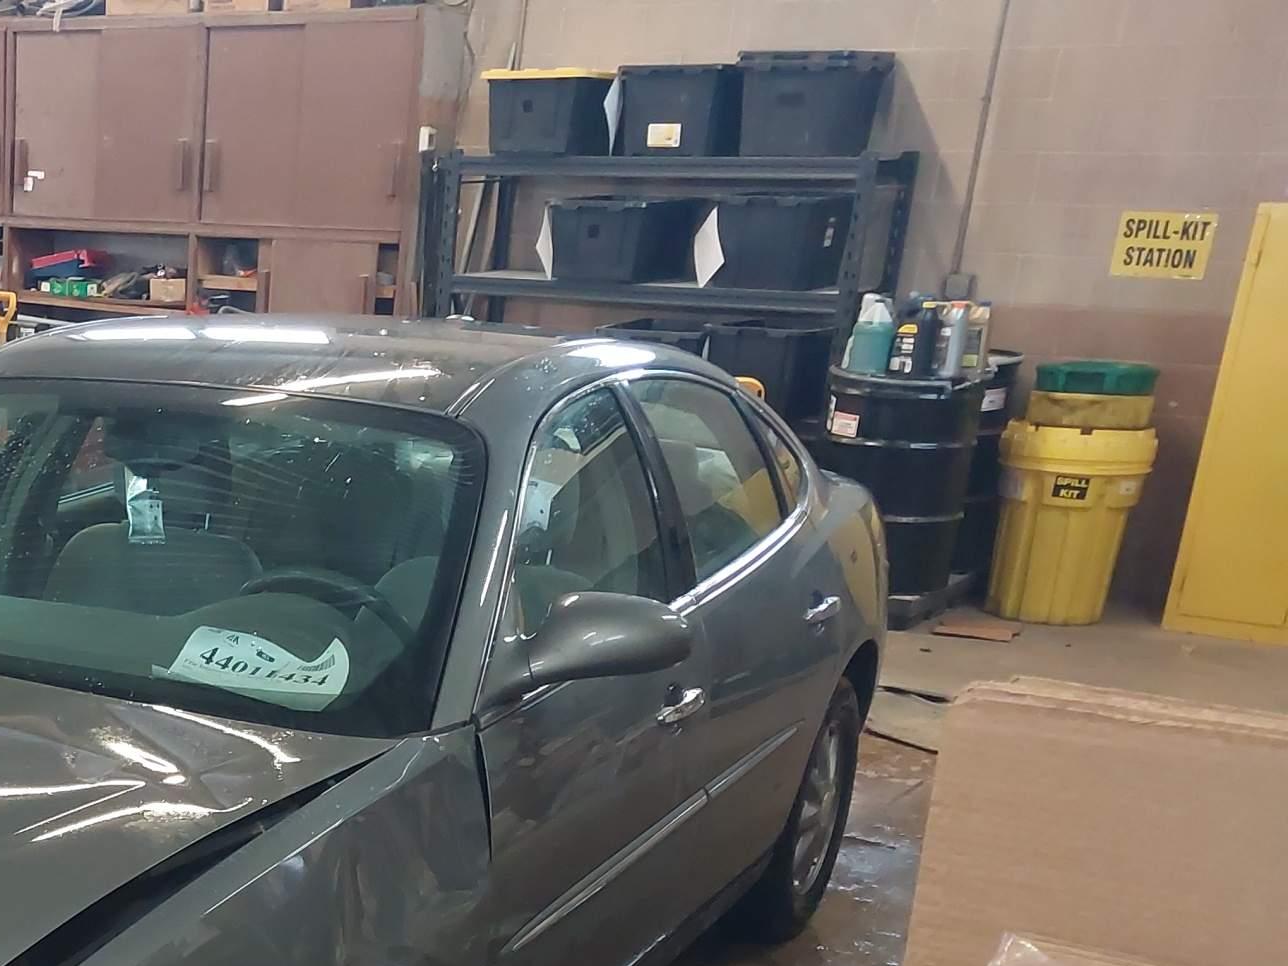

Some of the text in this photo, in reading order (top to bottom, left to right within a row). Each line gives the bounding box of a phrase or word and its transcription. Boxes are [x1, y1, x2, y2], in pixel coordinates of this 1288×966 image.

[1123, 218, 1212, 241] SPILL-KIT
[1123, 246, 1197, 269] STATION
[1056, 476, 1089, 488] SPILL
[1058, 488, 1081, 499] KIT
[199, 647, 329, 686] 44011434
